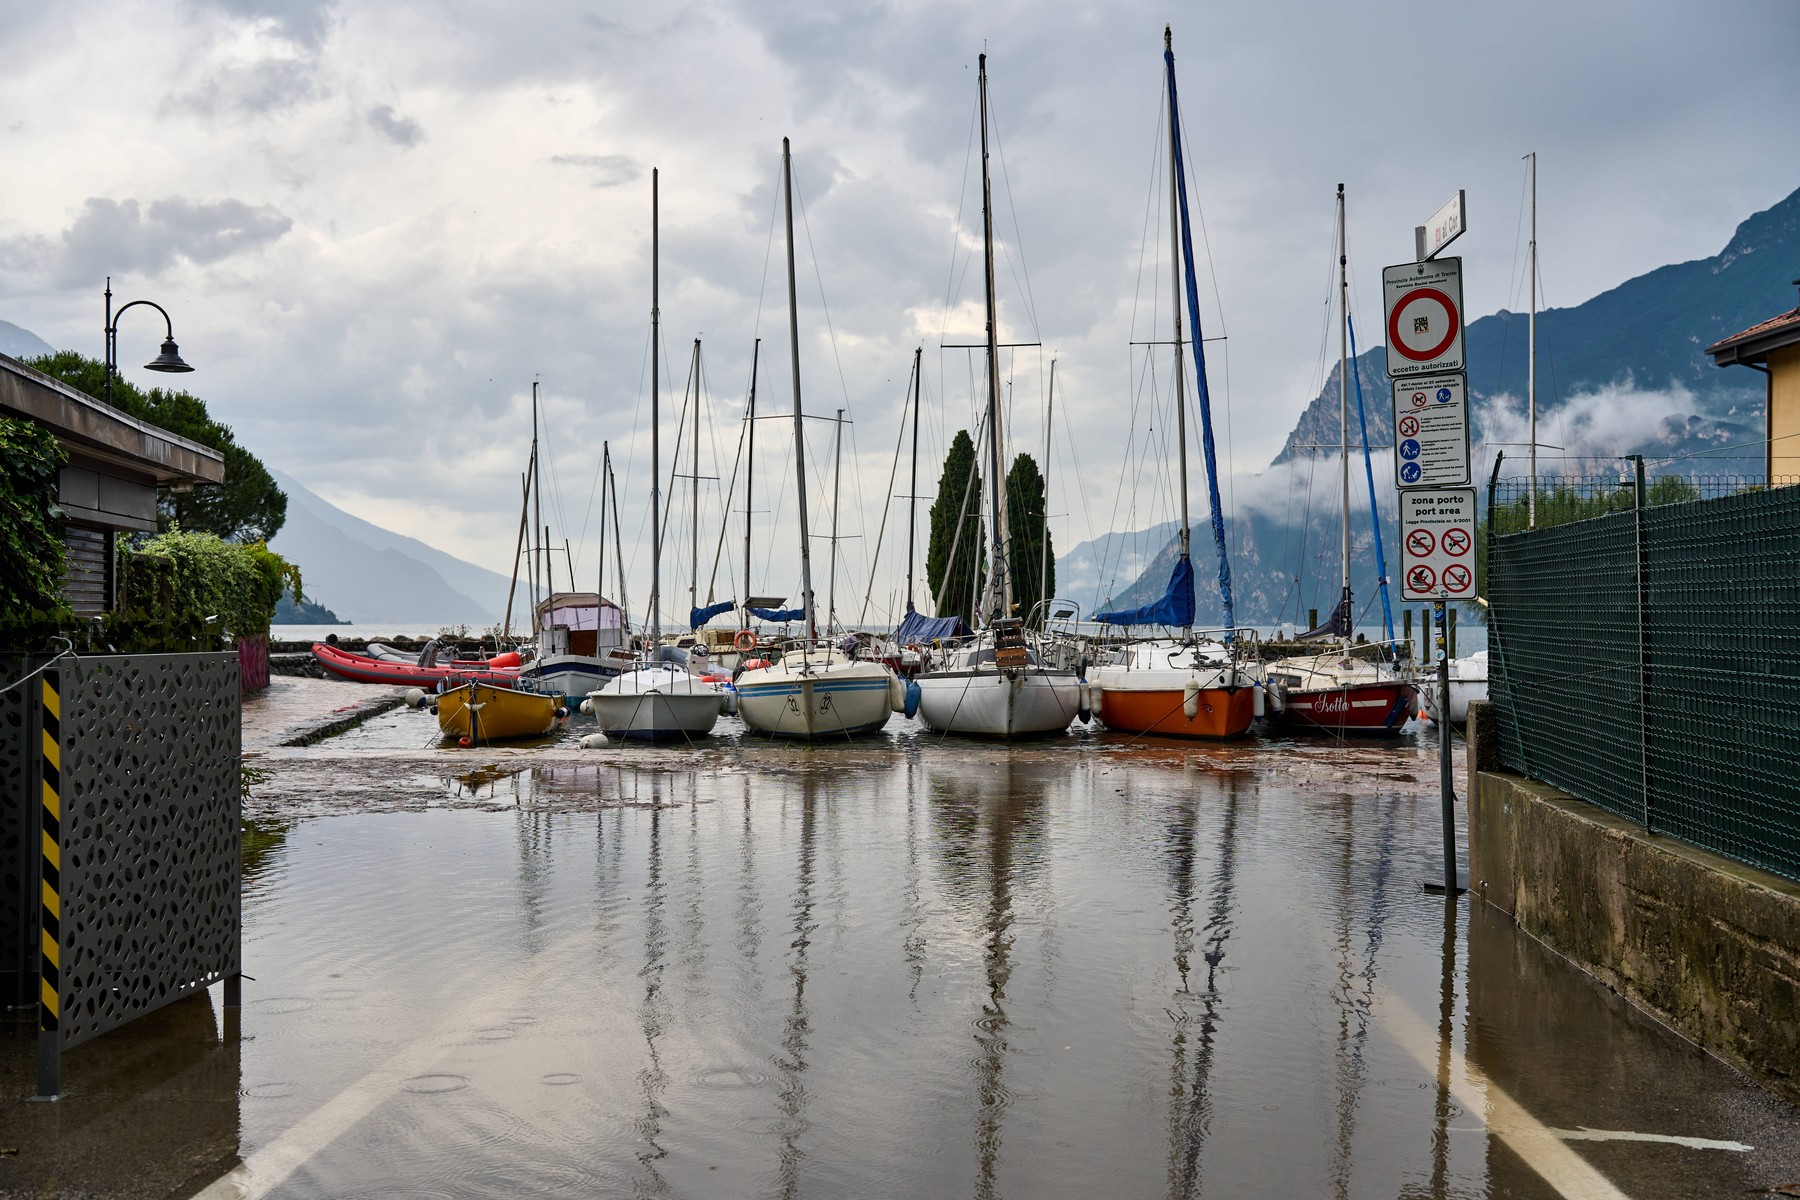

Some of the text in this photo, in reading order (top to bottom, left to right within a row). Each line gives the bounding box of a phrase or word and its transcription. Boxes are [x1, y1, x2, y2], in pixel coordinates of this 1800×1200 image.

[1393, 360, 1459, 373] eccetto autorizzati
[1411, 496, 1464, 505] zona porto
[1415, 507, 1436, 516] port
[1314, 692, 1350, 713] Isotta
